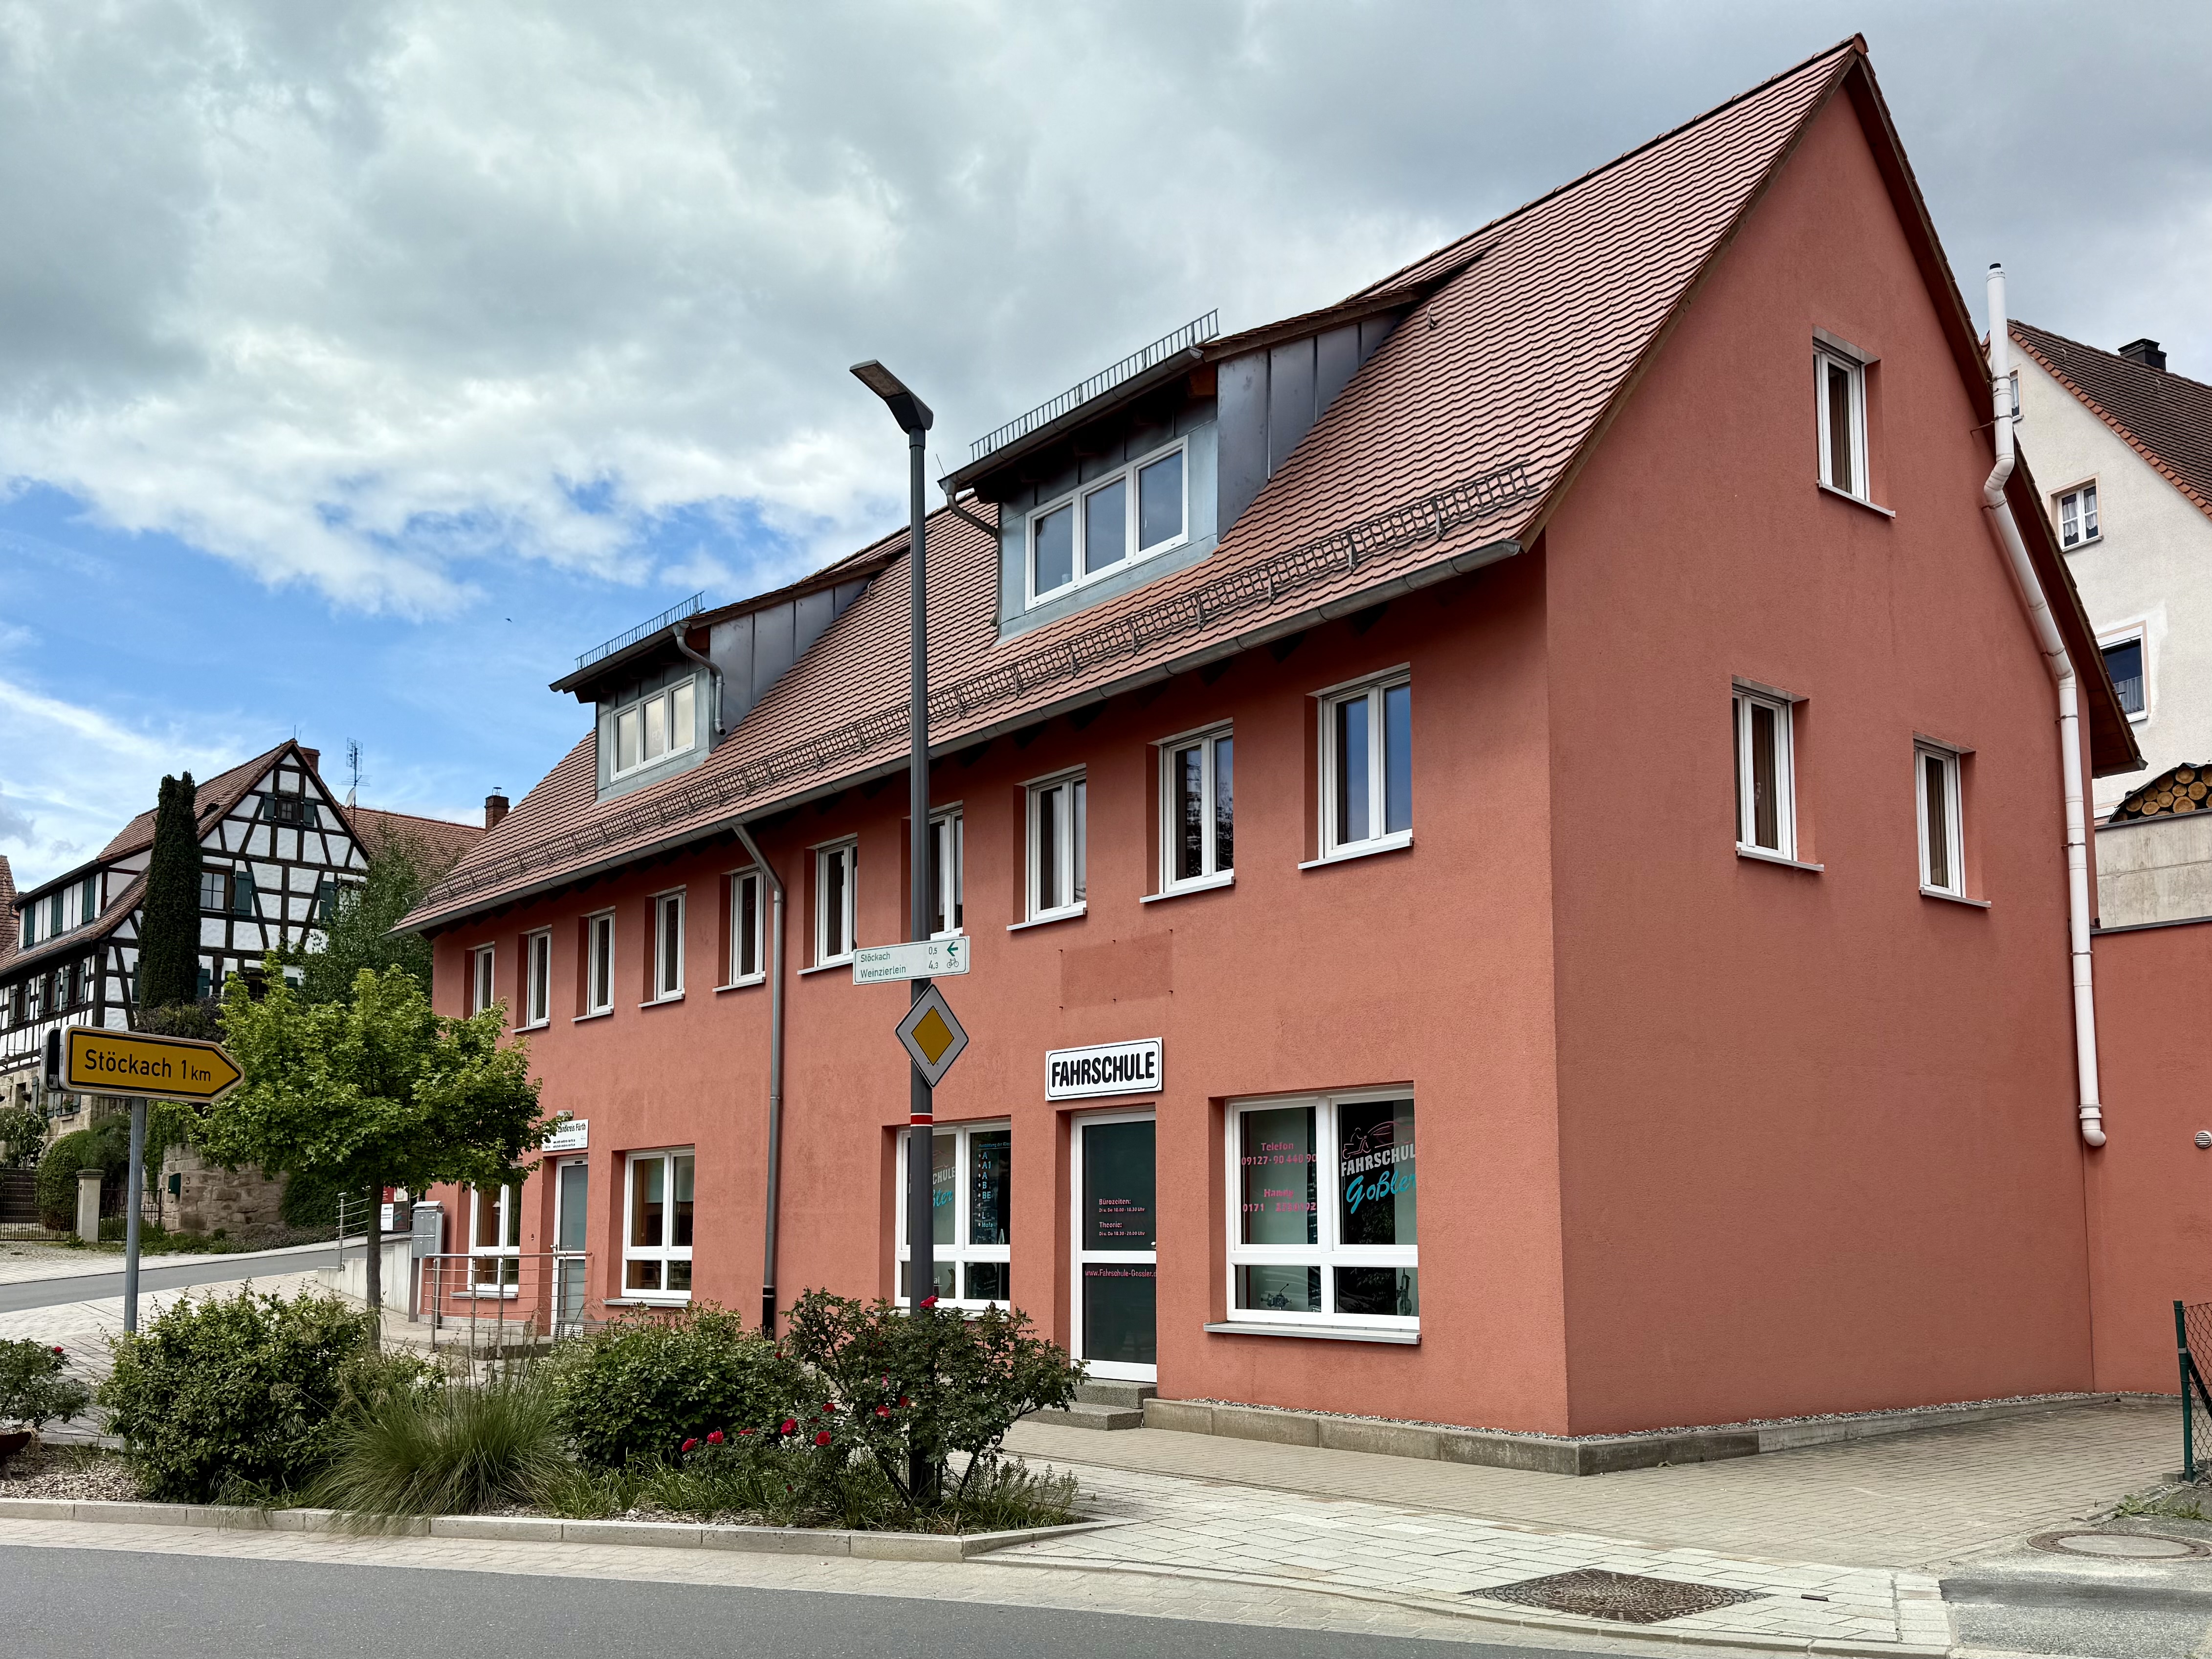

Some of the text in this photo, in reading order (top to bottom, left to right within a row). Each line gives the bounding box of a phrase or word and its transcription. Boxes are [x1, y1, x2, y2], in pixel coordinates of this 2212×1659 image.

[861, 946, 937, 962] Stöckach 0,5
[861, 960, 939, 978] Weinzierlein 4,3
[84, 1049, 211, 1082] Stöckach 1 km
[1052, 1051, 1155, 1088] FAHRSCHULE
[1261, 1142, 1294, 1151] Telefon
[982, 1161, 991, 1169] A1
[186, 1176, 191, 1185] 3
[933, 1167, 955, 1185] CHULE
[1263, 1189, 1294, 1199] Handy
[1346, 1169, 1416, 1214] Goßler
[1242, 1203, 1264, 1212] 0171
